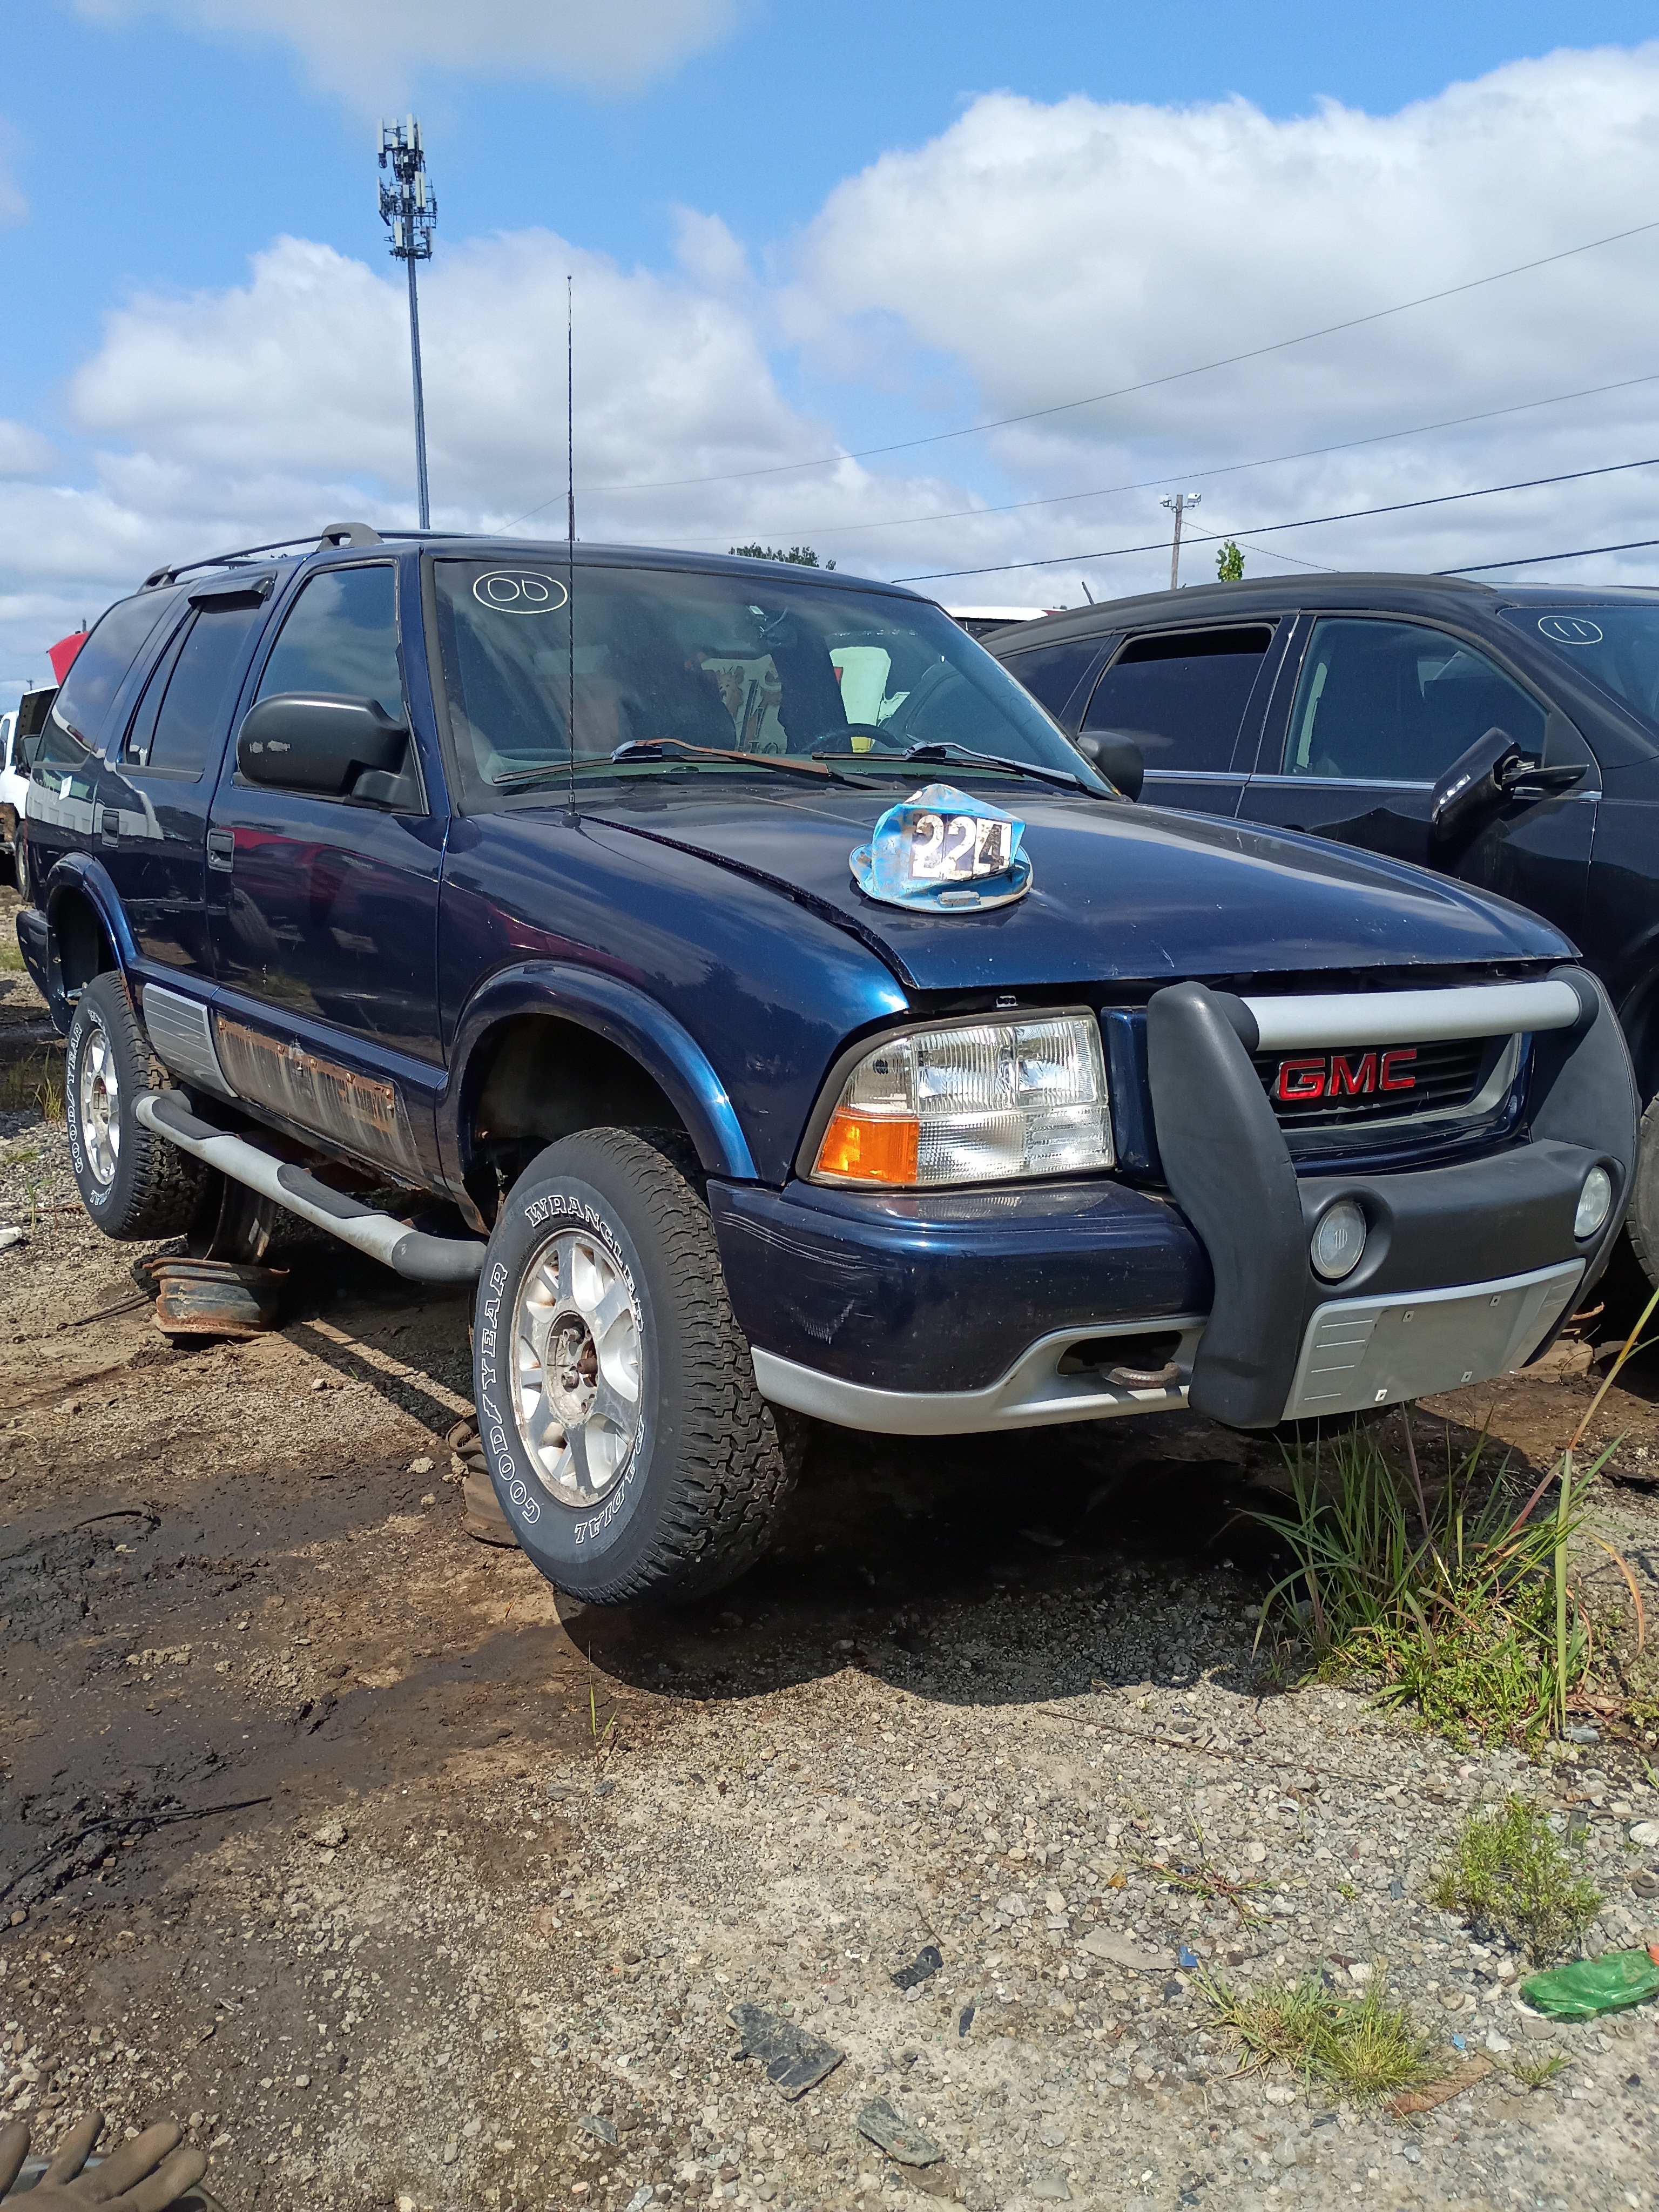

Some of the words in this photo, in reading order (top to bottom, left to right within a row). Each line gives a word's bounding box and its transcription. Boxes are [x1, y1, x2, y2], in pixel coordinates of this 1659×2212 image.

[912, 814, 1005, 881] 224
[1275, 1048, 1418, 1101] GMC
[482, 1262, 541, 1525] GOODYEAR
